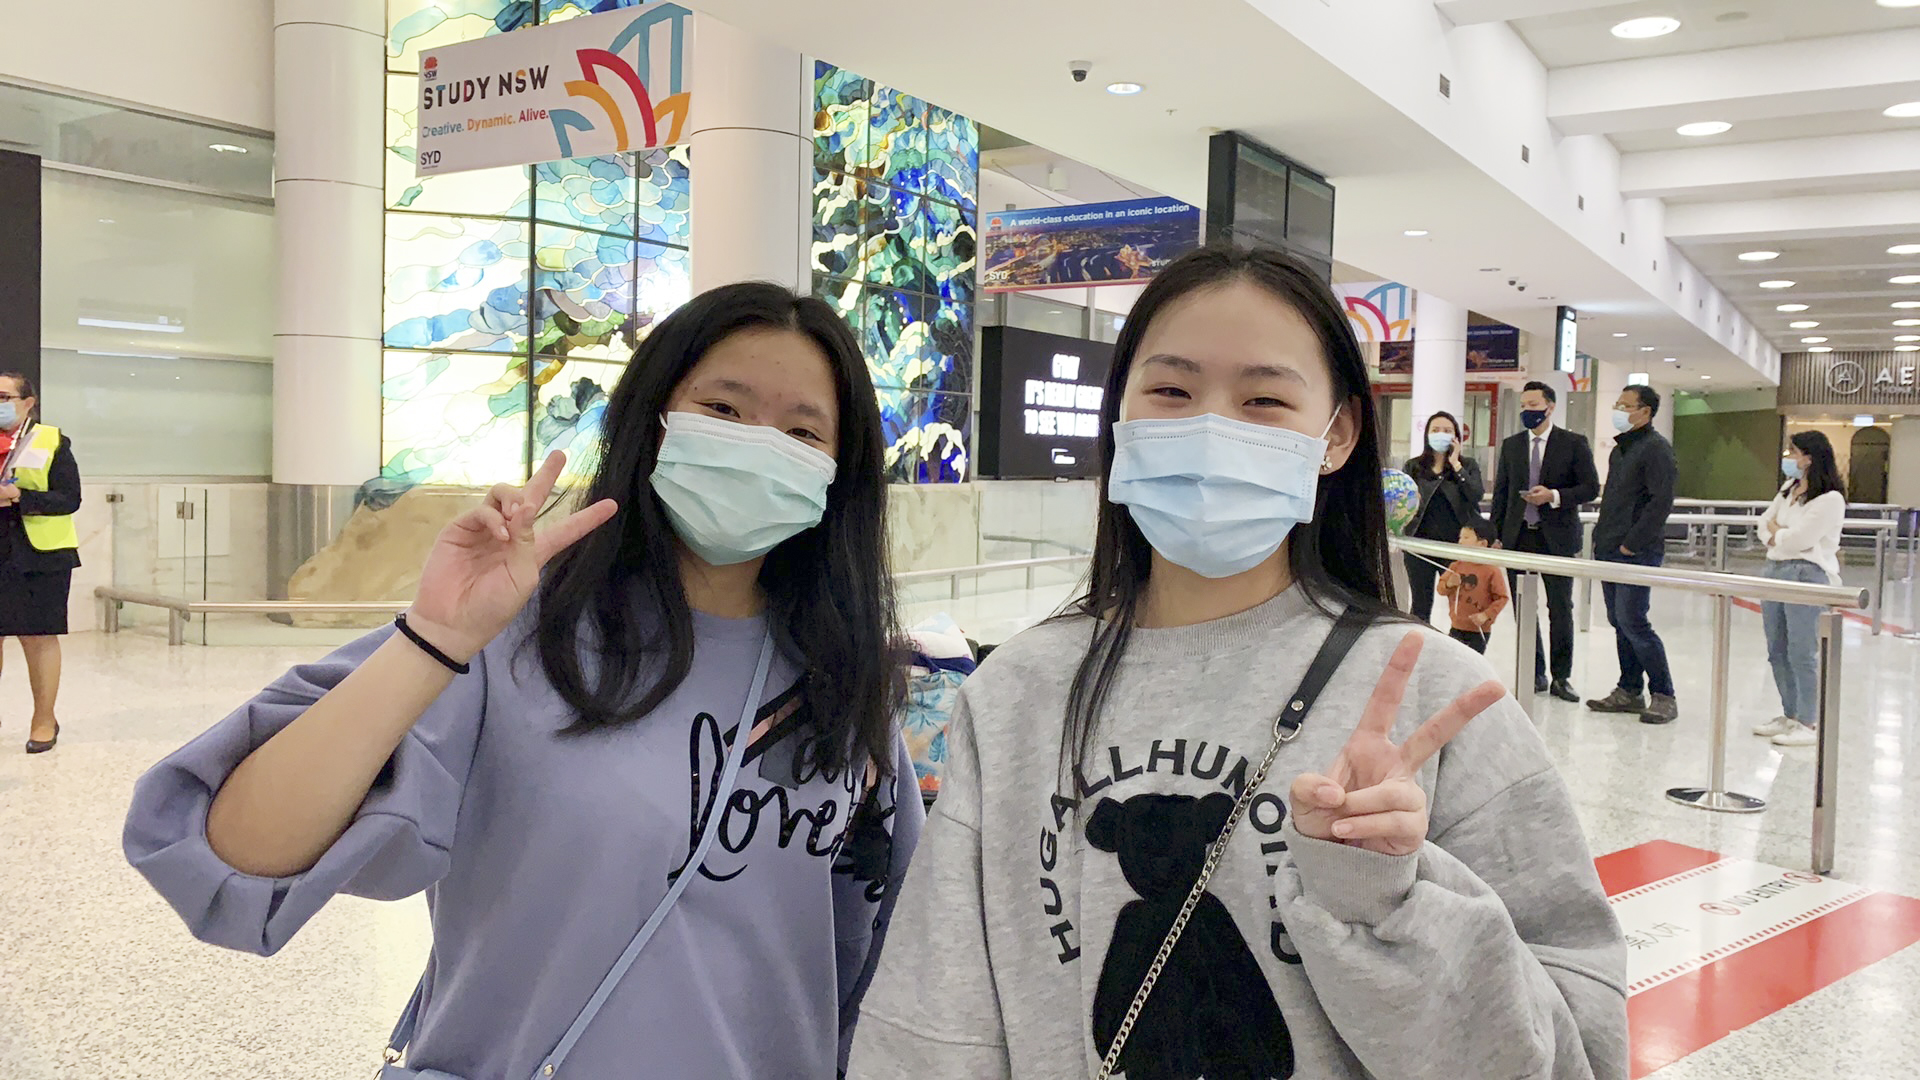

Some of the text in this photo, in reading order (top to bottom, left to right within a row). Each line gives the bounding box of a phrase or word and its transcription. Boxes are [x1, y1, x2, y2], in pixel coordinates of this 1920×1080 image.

[423, 65, 549, 110] STUDY NSW
[467, 113, 516, 132] Dynamic.
[518, 108, 549, 122] Alive.
[420, 150, 441, 166] SYD
[1018, 215, 1062, 226] world-class
[1063, 211, 1104, 222] education
[1105, 210, 1114, 218] in
[1127, 206, 1153, 217] iconic
[1154, 203, 1189, 214] location
[989, 270, 1008, 280] SYD
